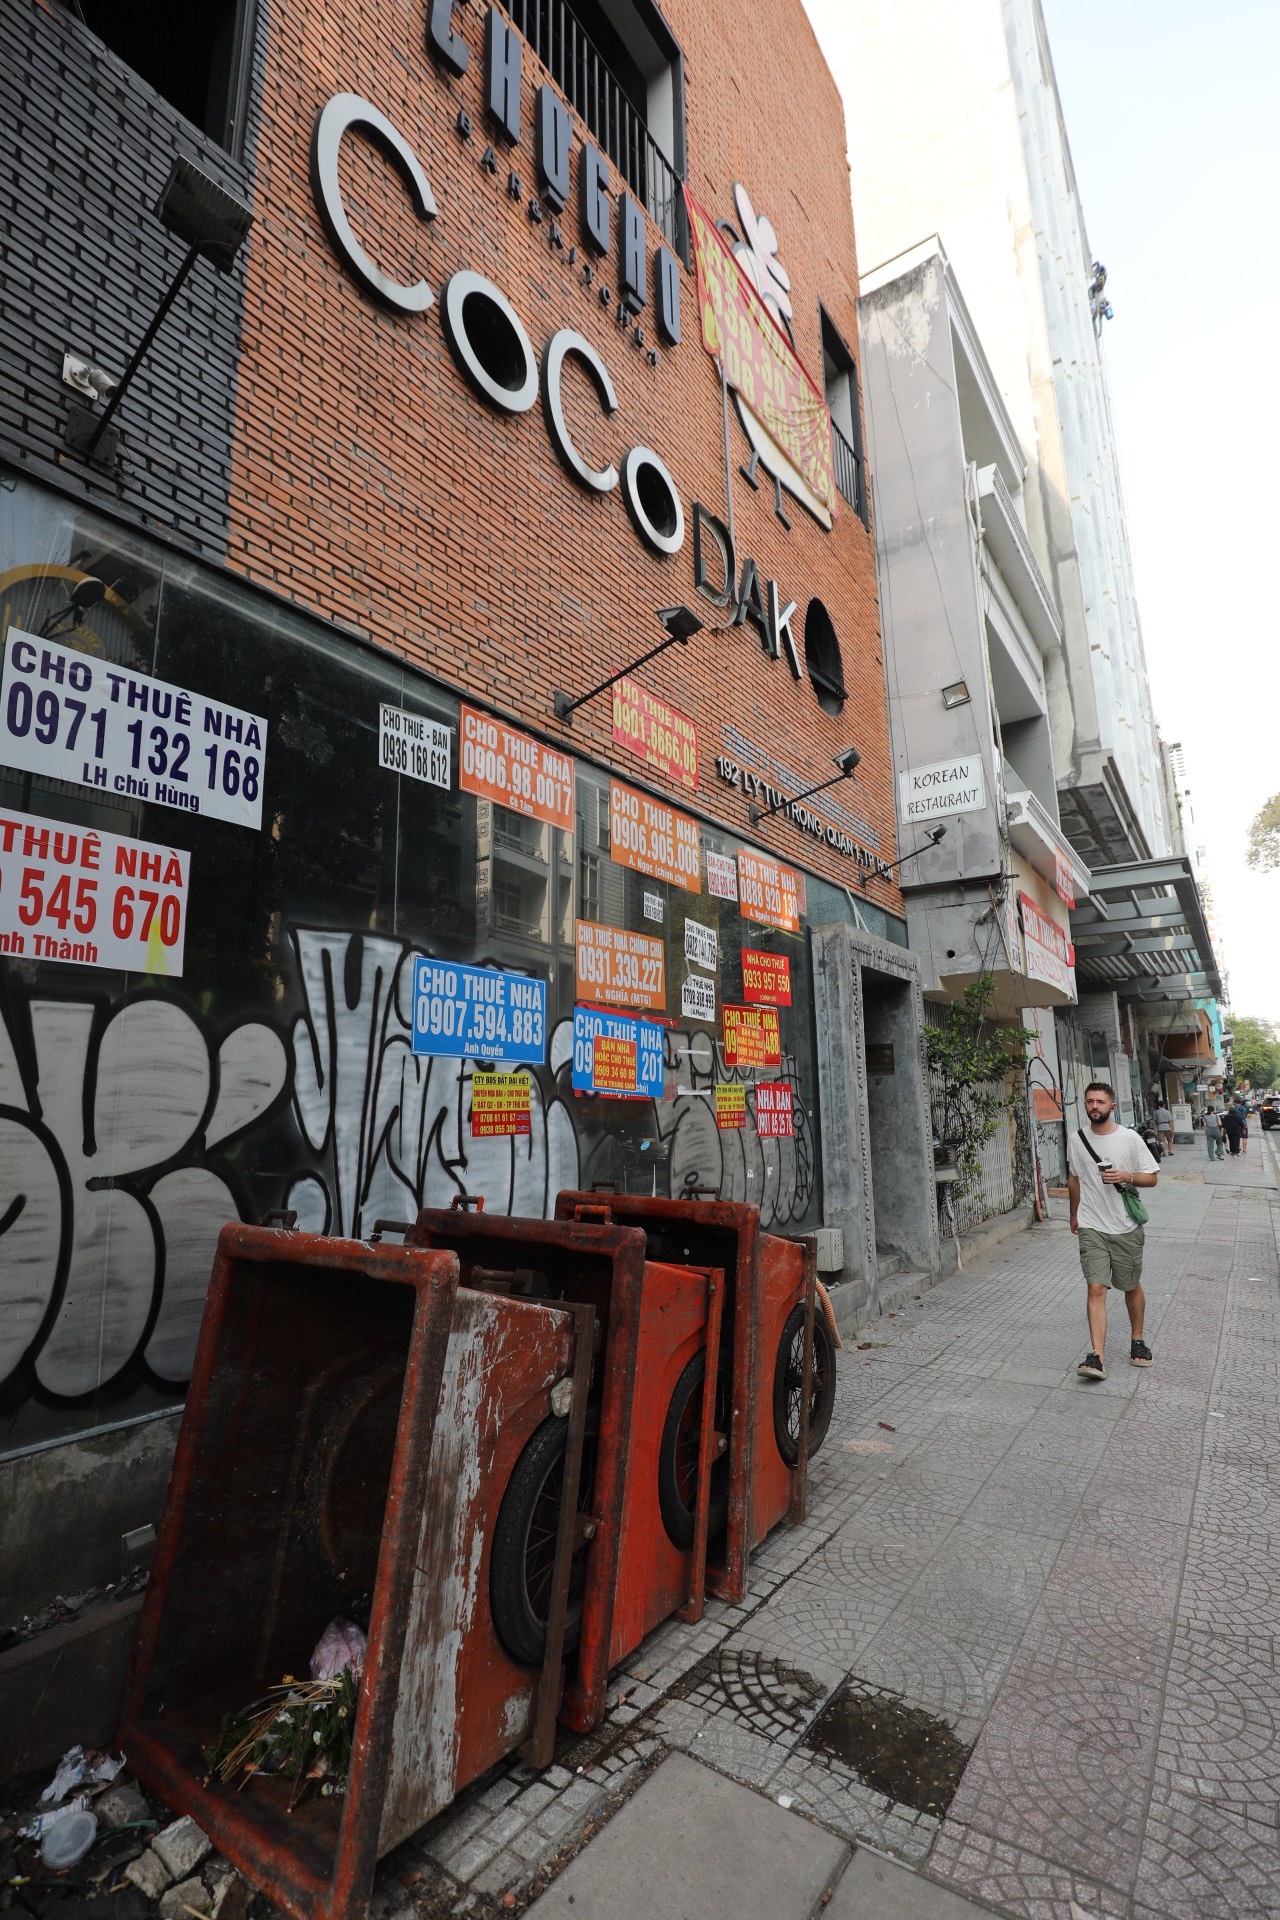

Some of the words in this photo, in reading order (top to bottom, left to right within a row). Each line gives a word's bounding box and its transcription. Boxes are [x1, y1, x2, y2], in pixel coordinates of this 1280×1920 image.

[11, 641, 92, 692] CHO
[107, 672, 192, 726] THUÊ
[204, 706, 261, 751] NHÀ
[613, 679, 639, 705] CHO
[642, 693, 672, 727] THUÊ
[675, 717, 696, 745] NHÀ
[7, 681, 107, 759] 0971
[128, 719, 191, 783] 132
[205, 743, 260, 802] 168
[382, 708, 401, 730] CHO
[403, 717, 424, 741] THUÊ
[432, 729, 448, 751] BÁN
[465, 715, 498, 749] CHO
[502, 732, 539, 769] THUÊ
[542, 752, 571, 784] NHÀ
[613, 697, 697, 775] 0901.6666.06
[382, 732, 408, 771] 0936
[410, 744, 428, 777] 168
[430, 751, 447, 785] 612
[463, 740, 572, 816] 0906.98.0017
[717, 755, 740, 785] 192
[912, 765, 970, 790] KOREAN
[83, 762, 108, 787] LH
[114, 773, 148, 798] chú
[156, 781, 200, 813] Hùng
[907, 788, 979, 816] RESTAURANT
[612, 787, 639, 819] CHO
[643, 801, 673, 835] THUÊ
[676, 818, 698, 847] NHÀ
[0, 819, 102, 871] THUÊ
[115, 845, 184, 888] NHÀ
[612, 813, 699, 877] 0906.905.006
[738, 855, 757, 879] CHO
[758, 863, 780, 888] THUÊ
[781, 872, 797, 894] NHÀ
[19, 867, 98, 934] 545
[112, 885, 181, 947] 670
[740, 876, 763, 908] 0888
[765, 886, 781, 914] 920
[783, 892, 798, 919] 130
[578, 924, 594, 944] CHO
[595, 928, 613, 949] THUÊ
[613, 932, 628, 952] NHÀ
[629, 934, 649, 957] CHÍNH
[649, 940, 662, 959] CHỦ
[1022, 902, 1039, 940] CHO
[33, 934, 98, 963] Thành
[578, 944, 663, 993] 0931.339.227
[746, 953, 760, 966] NHÀ
[760, 956, 772, 969] CHO
[772, 958, 785, 970] THUÊ
[419, 966, 457, 998] CHO
[462, 973, 505, 1005] THUÊ
[510, 981, 542, 1011] NHÀ
[595, 987, 603, 999] A.
[605, 989, 629, 1003] NGHĨA
[630, 992, 652, 1007] (MTG)
[743, 968, 761, 989] 0933
[763, 972, 776, 991] 957
[777, 974, 790, 993] 550
[416, 995, 542, 1046] 0907.594.883
[575, 1013, 603, 1039] CHO
[606, 1020, 637, 1042] THUÊ
[640, 1026, 662, 1051] NHÀ
[724, 1010, 741, 1028] CHO
[743, 1008, 761, 1029] THUÊ
[762, 1011, 778, 1030] NHÀ
[464, 1042, 479, 1055] Anh
[601, 1039, 616, 1053] BÁN
[616, 1042, 630, 1055] NHÀ
[610, 1053, 622, 1065] CHO
[474, 1075, 485, 1085] CTY
[757, 1086, 774, 1110] NHÀ
[775, 1087, 791, 1110] BÁN
